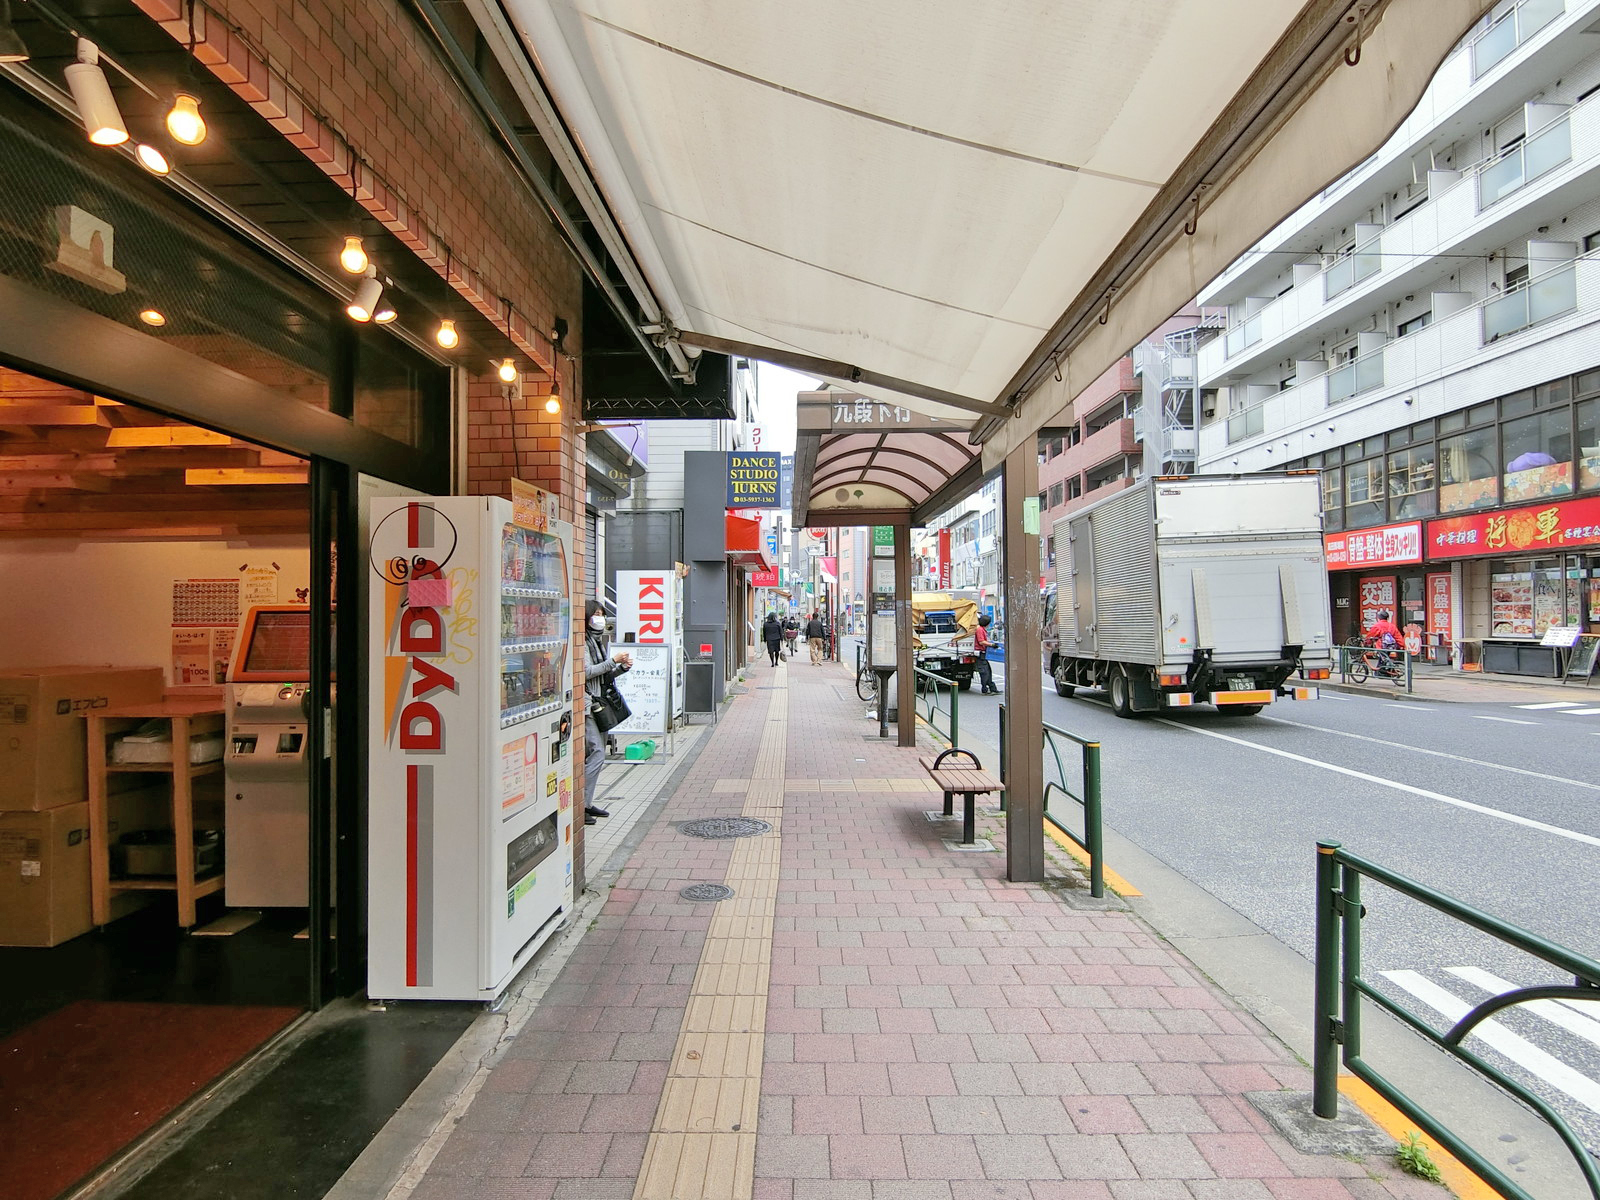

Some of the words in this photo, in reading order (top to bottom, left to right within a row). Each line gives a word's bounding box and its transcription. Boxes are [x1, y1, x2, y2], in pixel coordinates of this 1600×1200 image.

[731, 457, 777, 468] DANCE
[730, 469, 778, 479] STUDIO
[731, 481, 777, 494] TURNS
[1362, 581, 1393, 606] 交通
